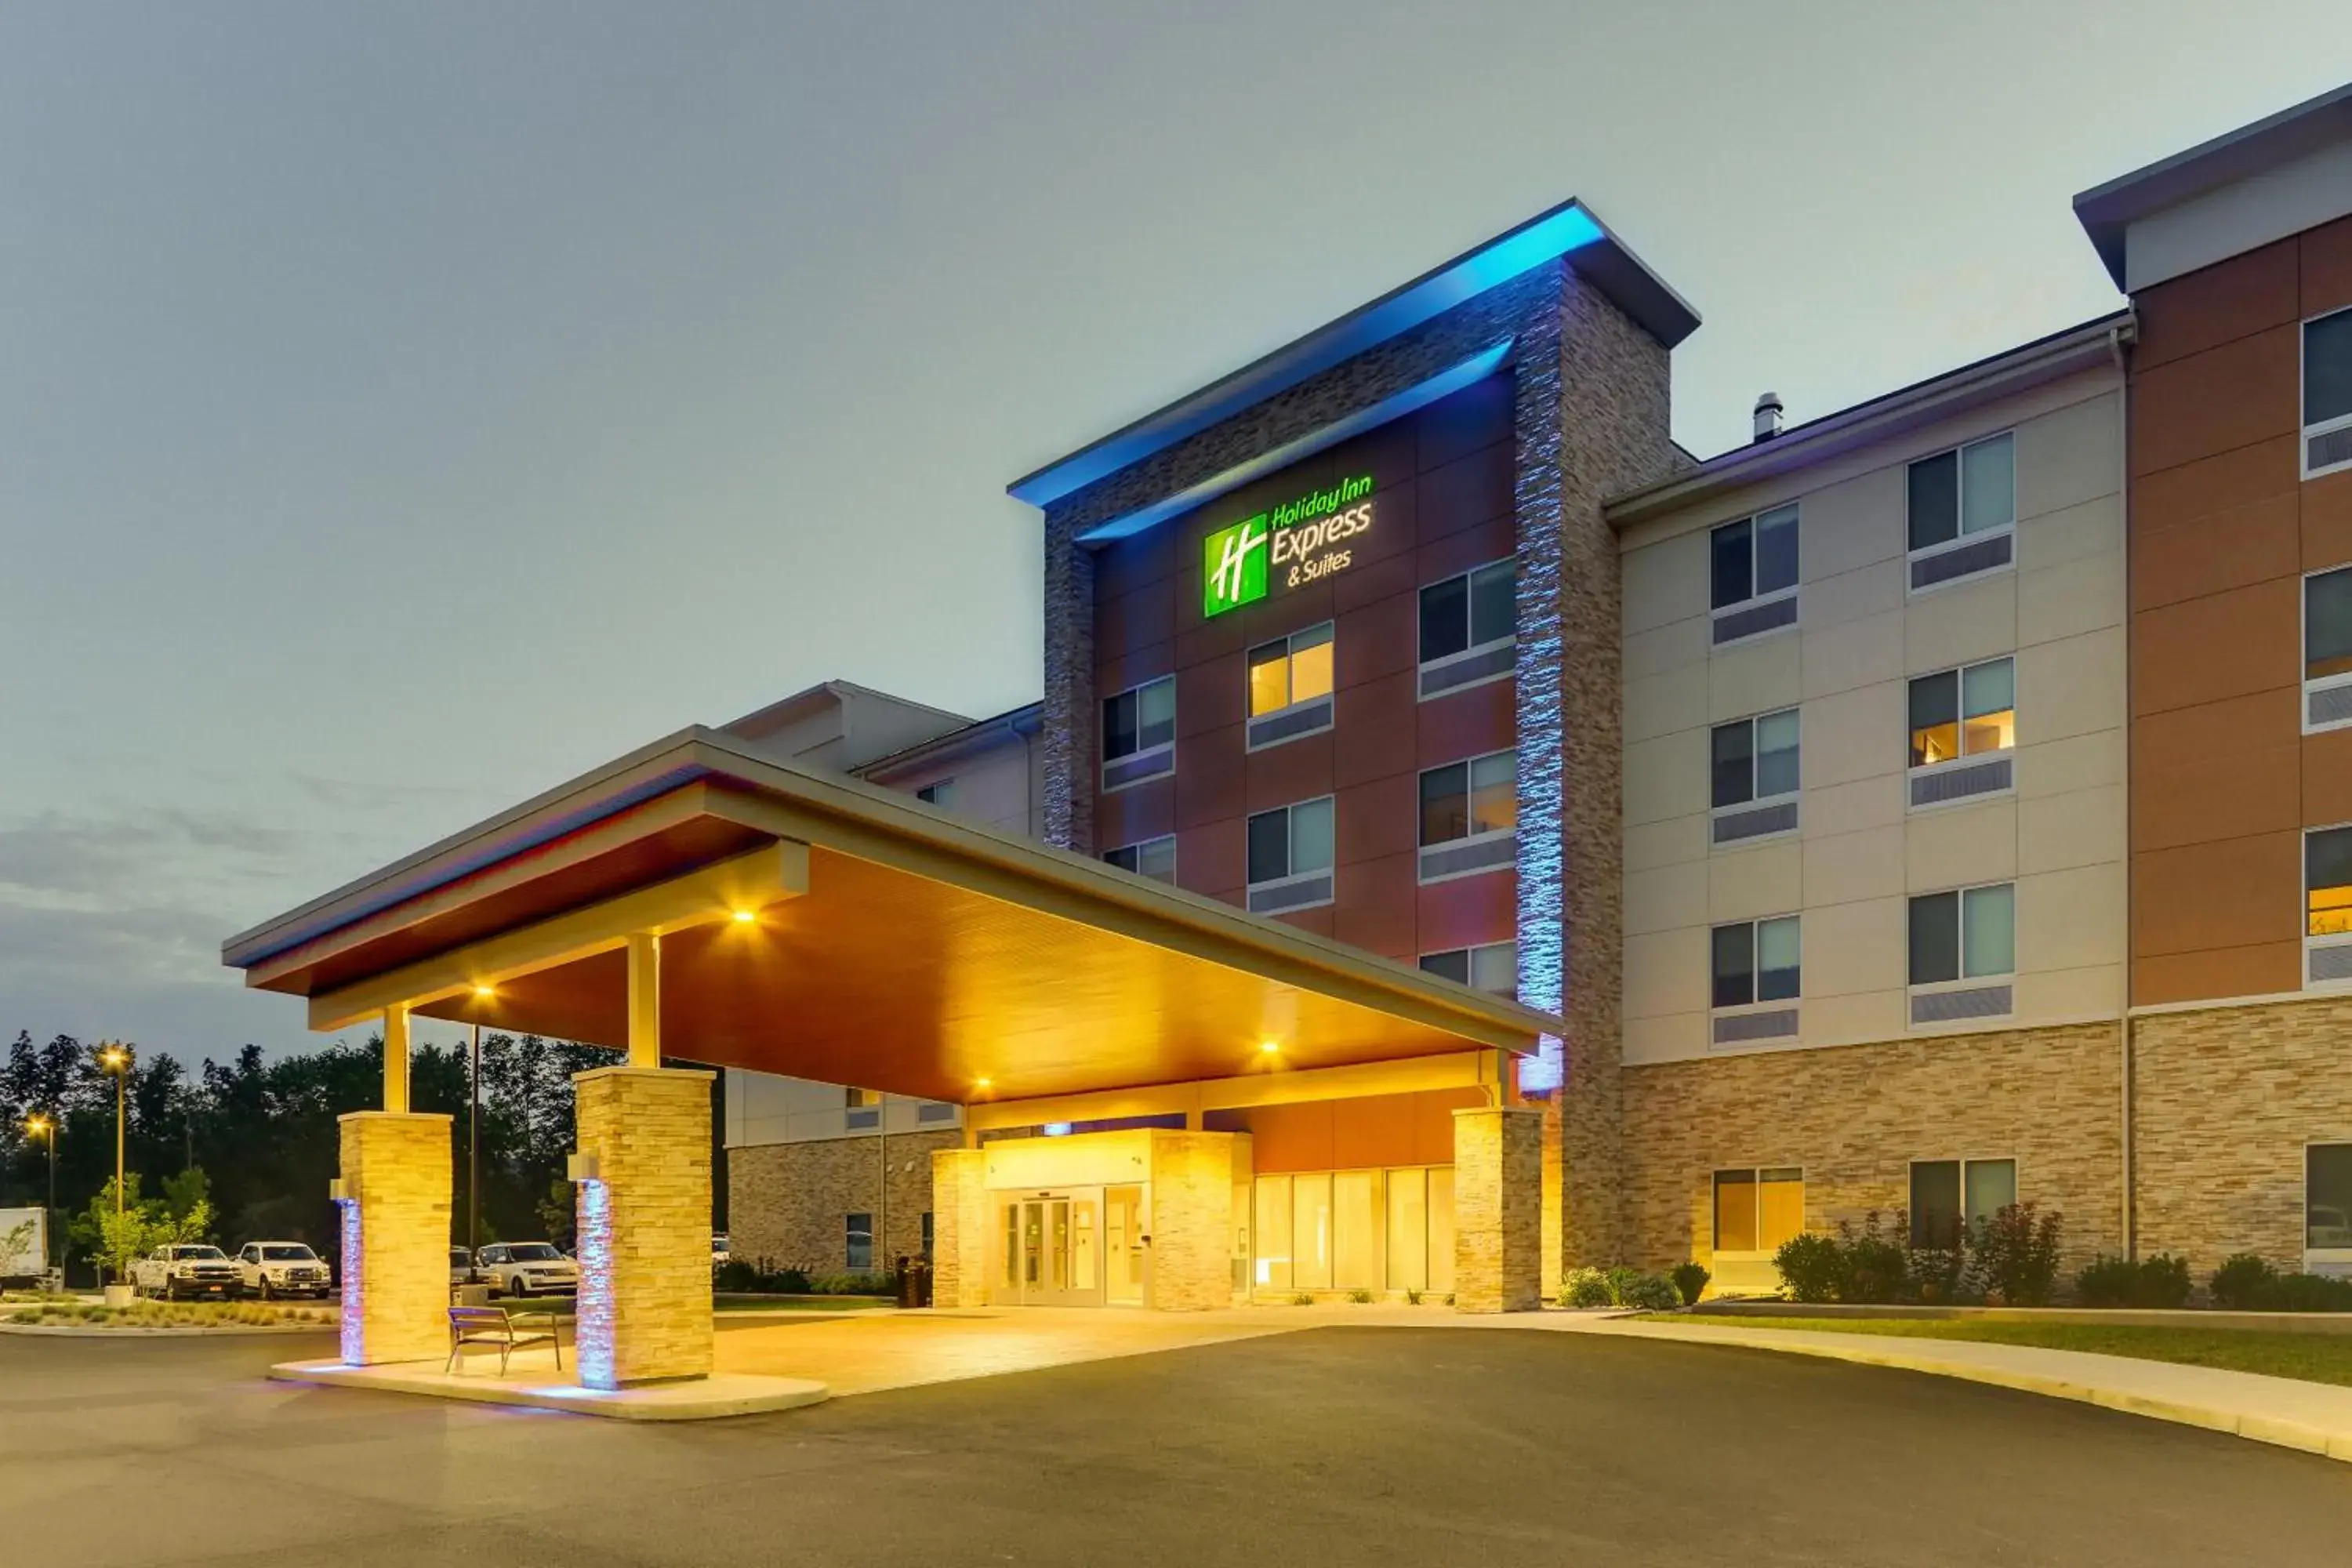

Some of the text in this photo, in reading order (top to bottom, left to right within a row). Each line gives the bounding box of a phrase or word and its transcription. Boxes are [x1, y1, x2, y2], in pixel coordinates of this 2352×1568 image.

[1272, 477, 1371, 531] Holiday Inn
[1272, 503, 1371, 564] Express
[1287, 550, 1352, 587] & Suites
